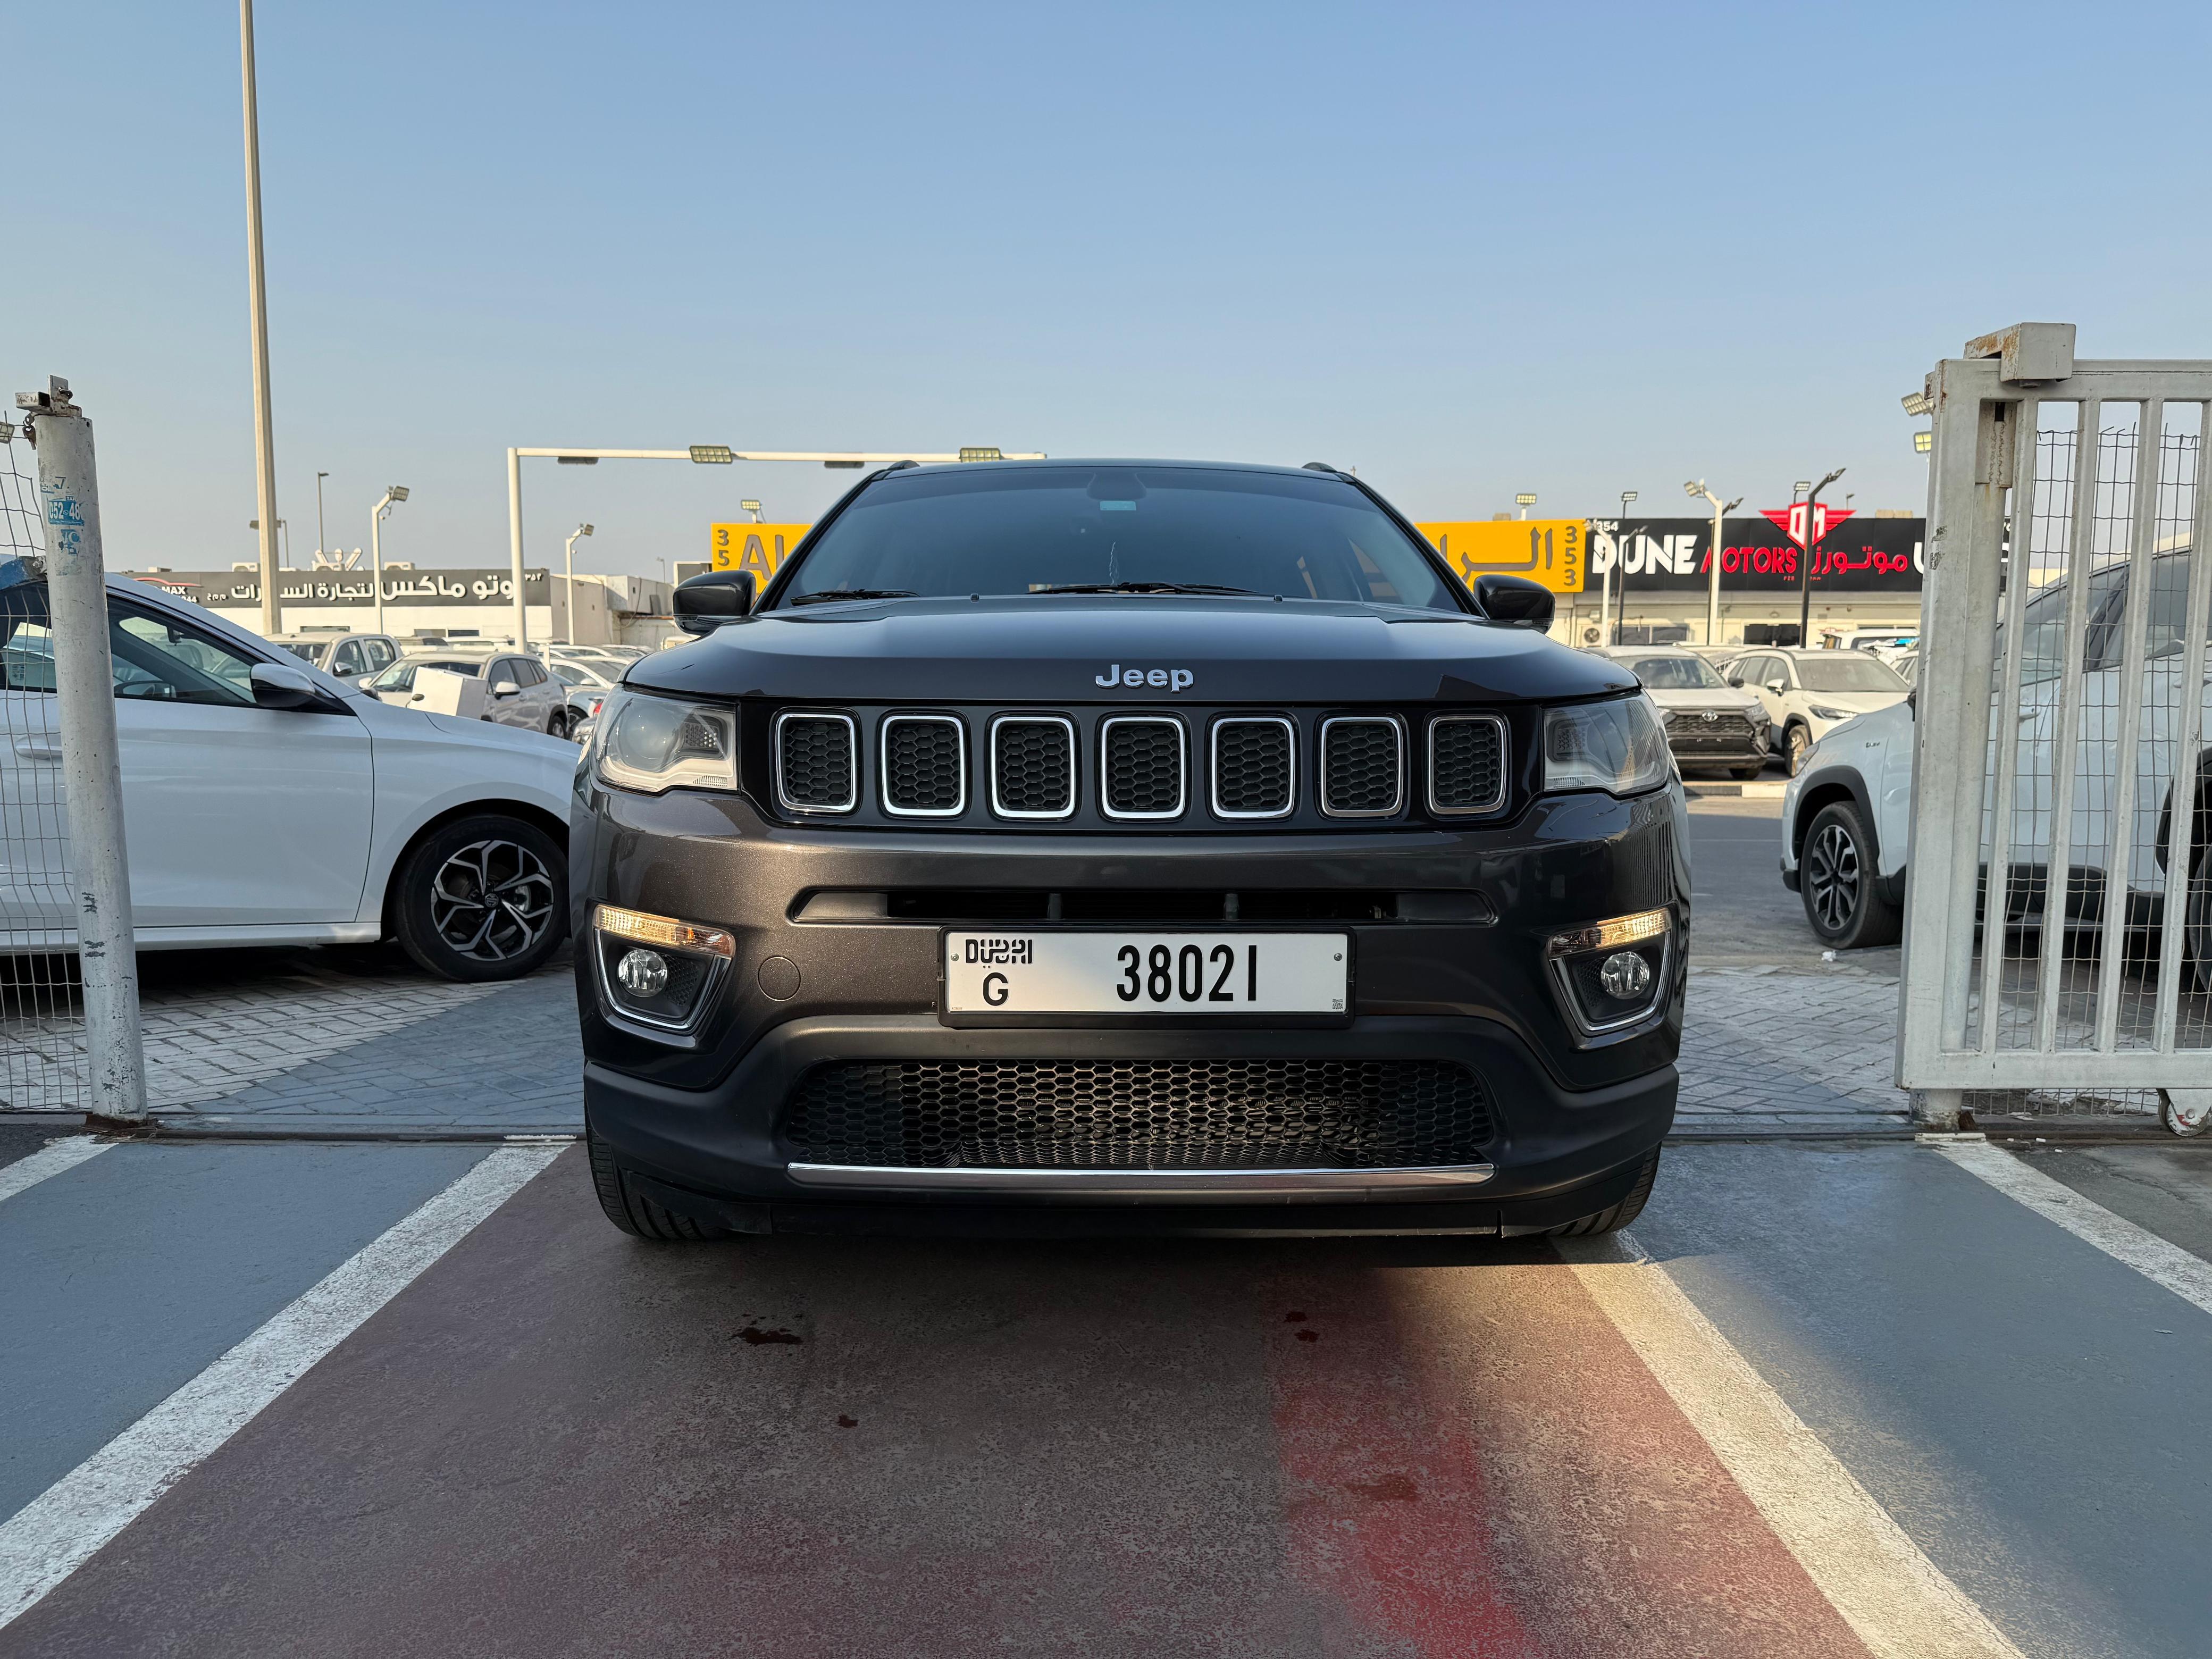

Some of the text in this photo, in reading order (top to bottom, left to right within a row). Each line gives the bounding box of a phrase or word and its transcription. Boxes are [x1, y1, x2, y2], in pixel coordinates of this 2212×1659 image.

[1592, 534, 1697, 574] DUNE
[1810, 546, 1908, 574] موتورز
[381, 575, 466, 600] ماكس
[1095, 664, 1194, 693] Jeep
[1117, 944, 1257, 1002] 38021
[983, 972, 1009, 1006] G
